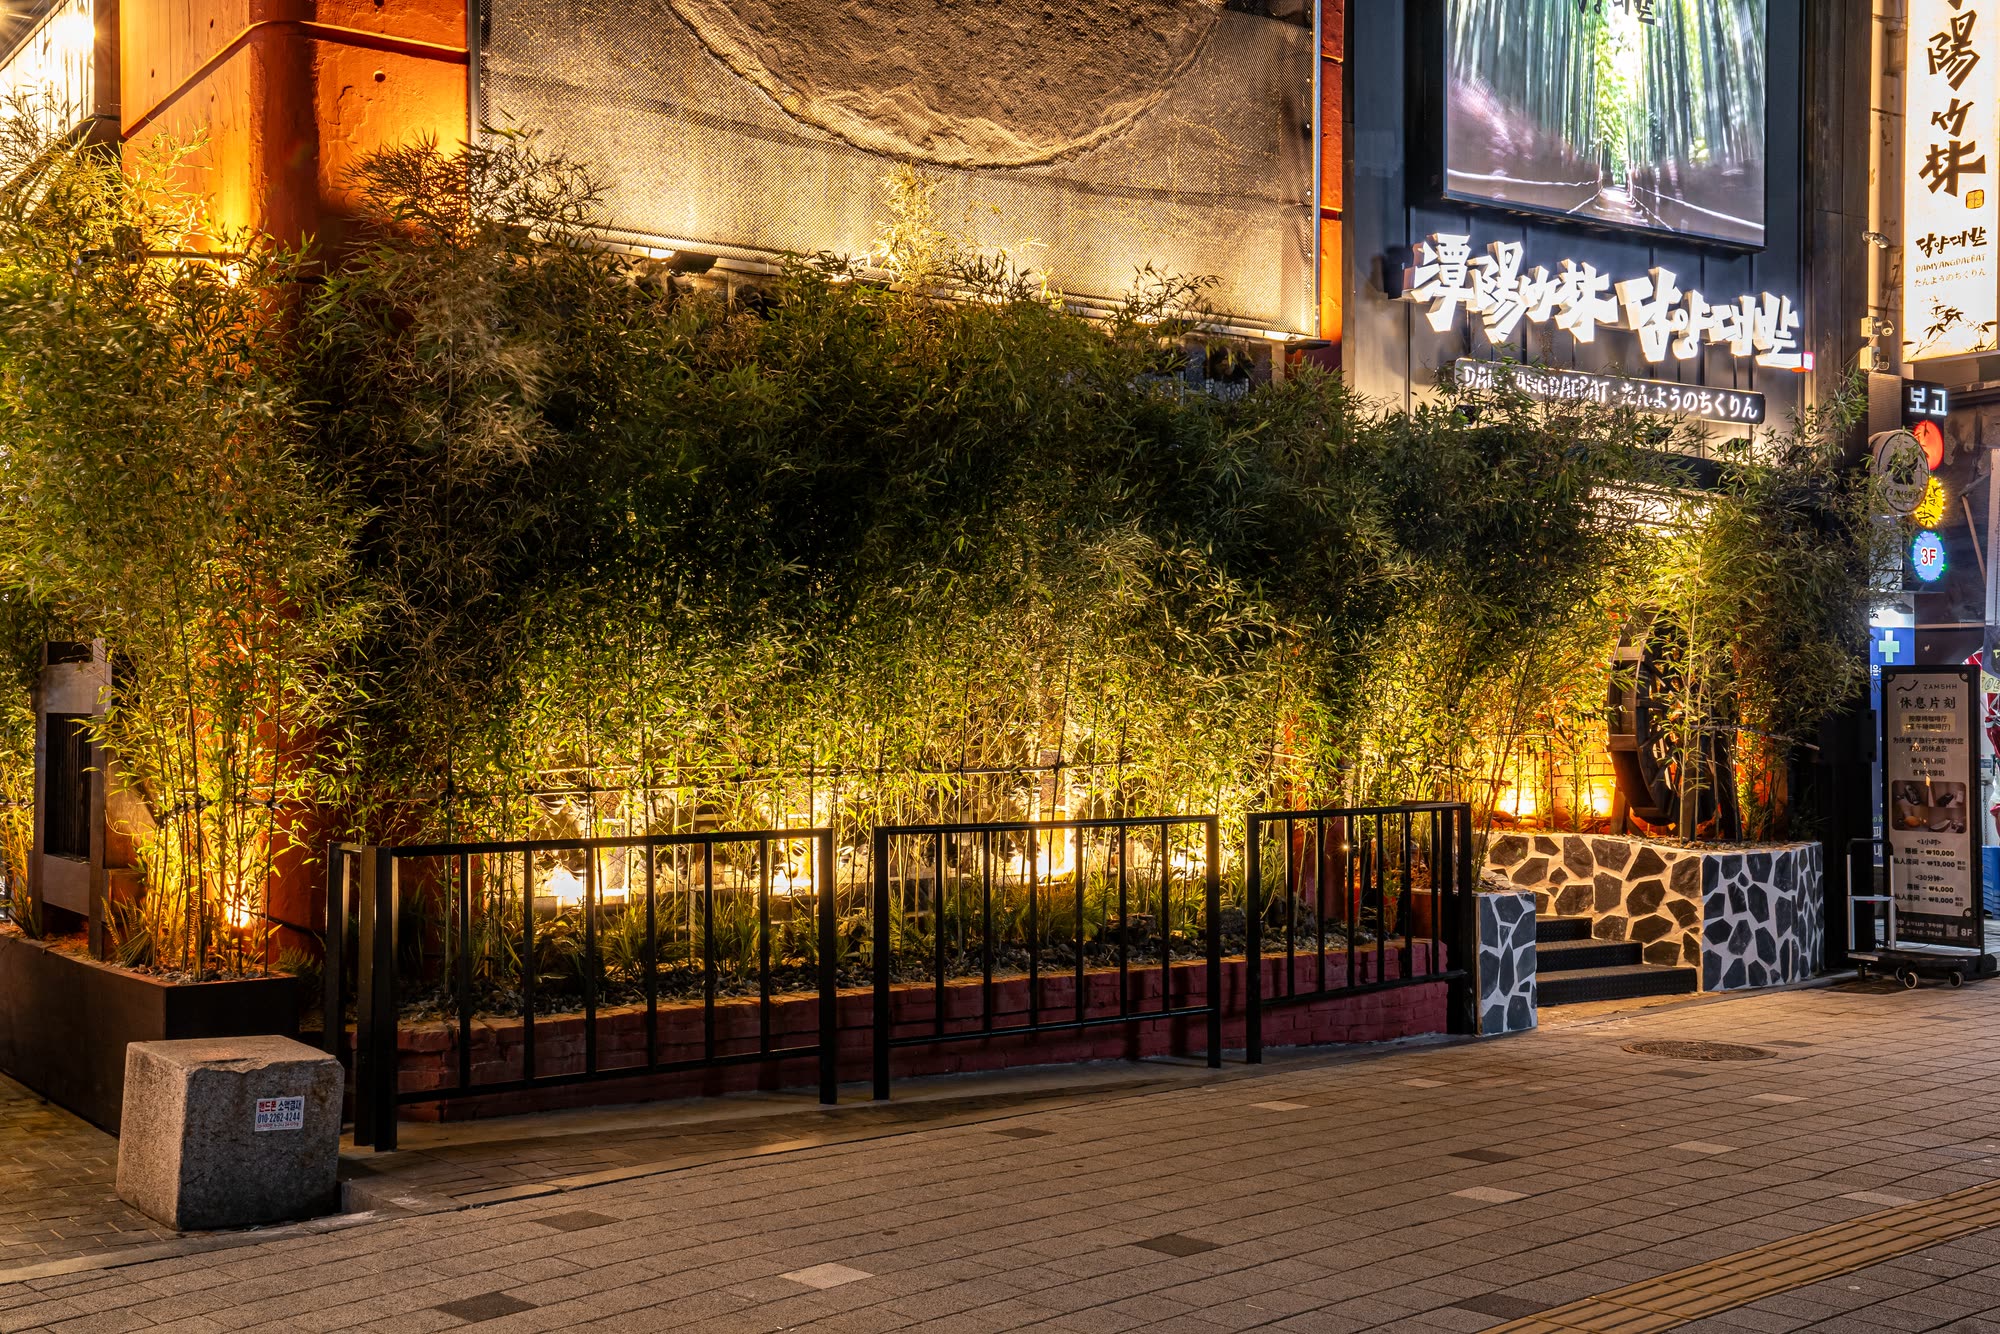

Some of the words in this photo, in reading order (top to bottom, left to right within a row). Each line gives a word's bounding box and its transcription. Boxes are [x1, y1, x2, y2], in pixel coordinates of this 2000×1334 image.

[1919, 0, 1987, 197] 陽竹林
[1915, 226, 1988, 258] 담양대밭
[1915, 253, 1987, 273] DAMYANGDAEBAT
[1914, 268, 1986, 288] たんようのちくりん
[1615, 266, 1804, 369] 담양대밭
[1621, 382, 1758, 419] たんようのちくりん
[1921, 548, 1937, 565] 3F
[1900, 697, 1956, 709] 休息片刻
[1961, 928, 1973, 937] 8F
